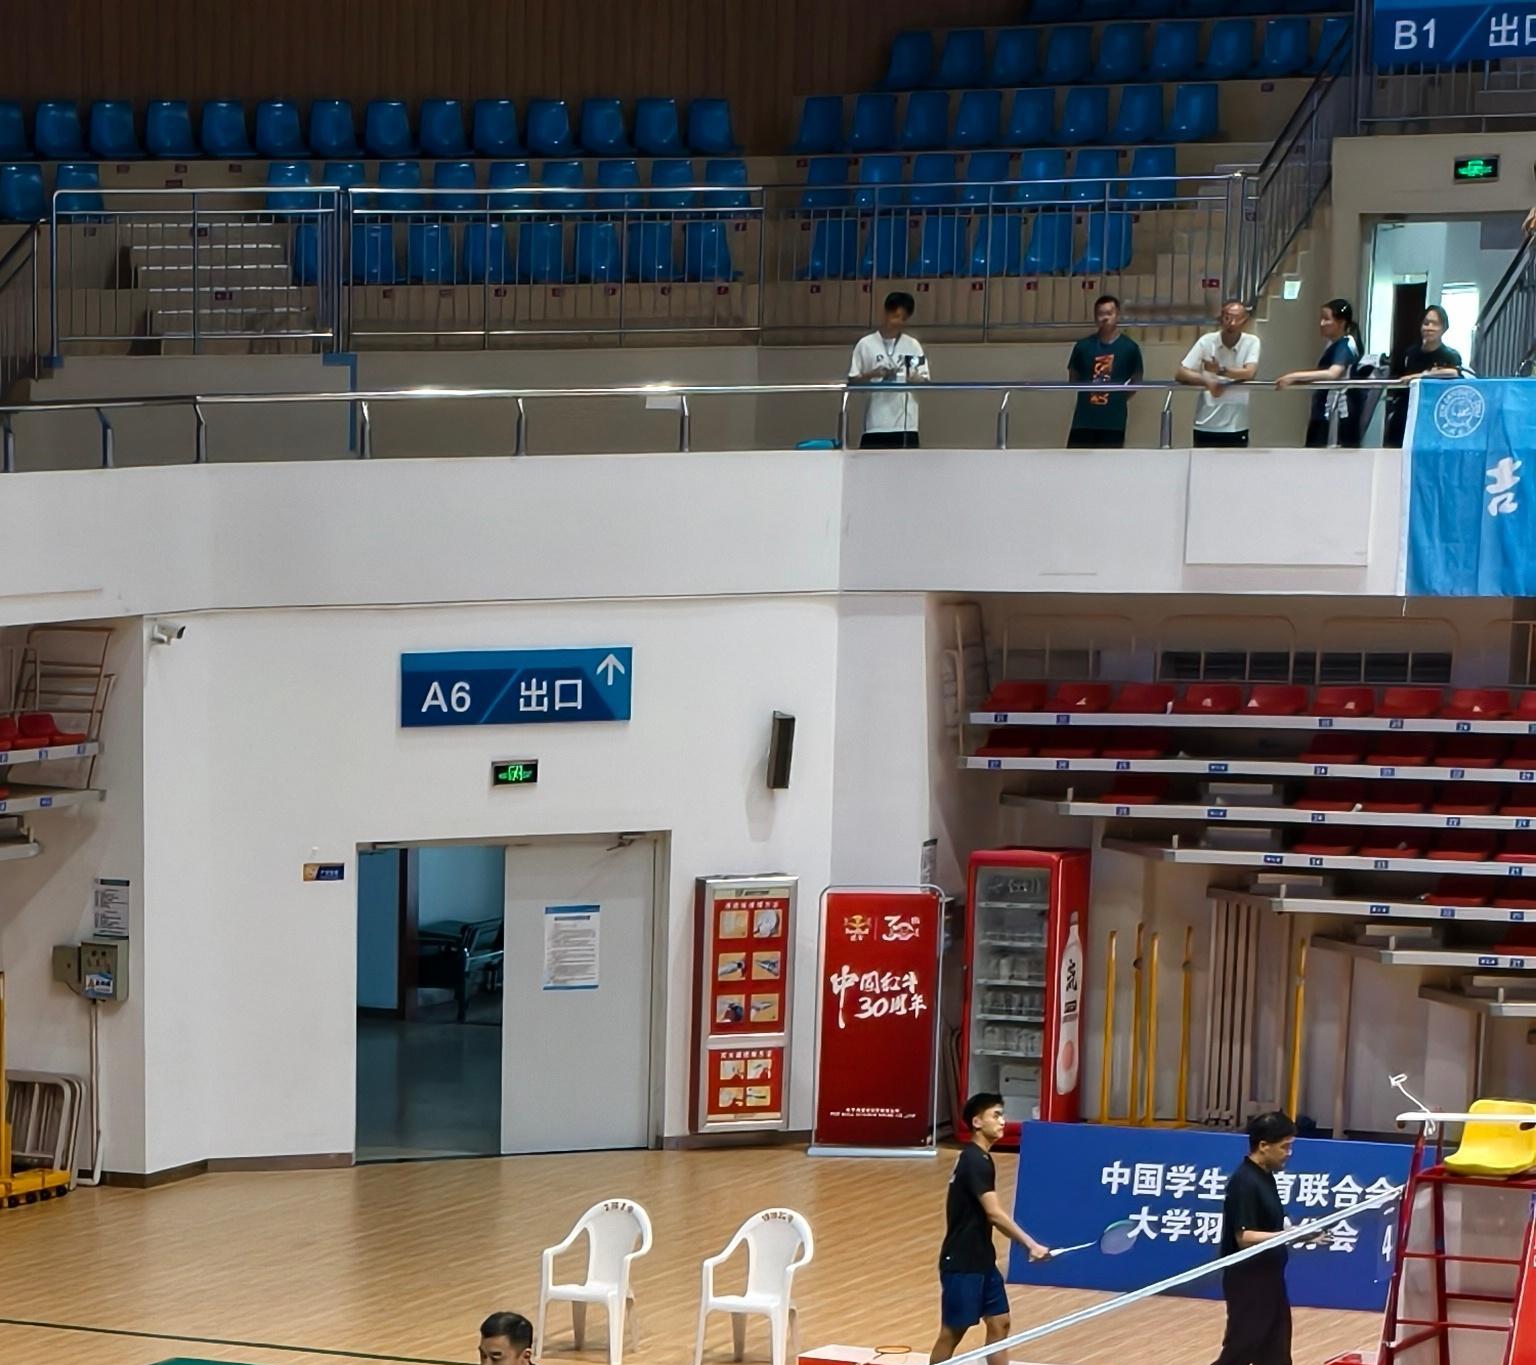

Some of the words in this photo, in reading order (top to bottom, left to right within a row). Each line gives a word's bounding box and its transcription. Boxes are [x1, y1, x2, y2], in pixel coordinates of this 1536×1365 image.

[1394, 18, 1436, 50] B1
[421, 681, 471, 713] A6
[519, 678, 582, 713] 出口
[830, 965, 918, 1028] 中国红牛
[854, 994, 927, 1019] 30周年
[1101, 1160, 1395, 1209] 中国学生育联合会
[1382, 1225, 1392, 1262] 4
